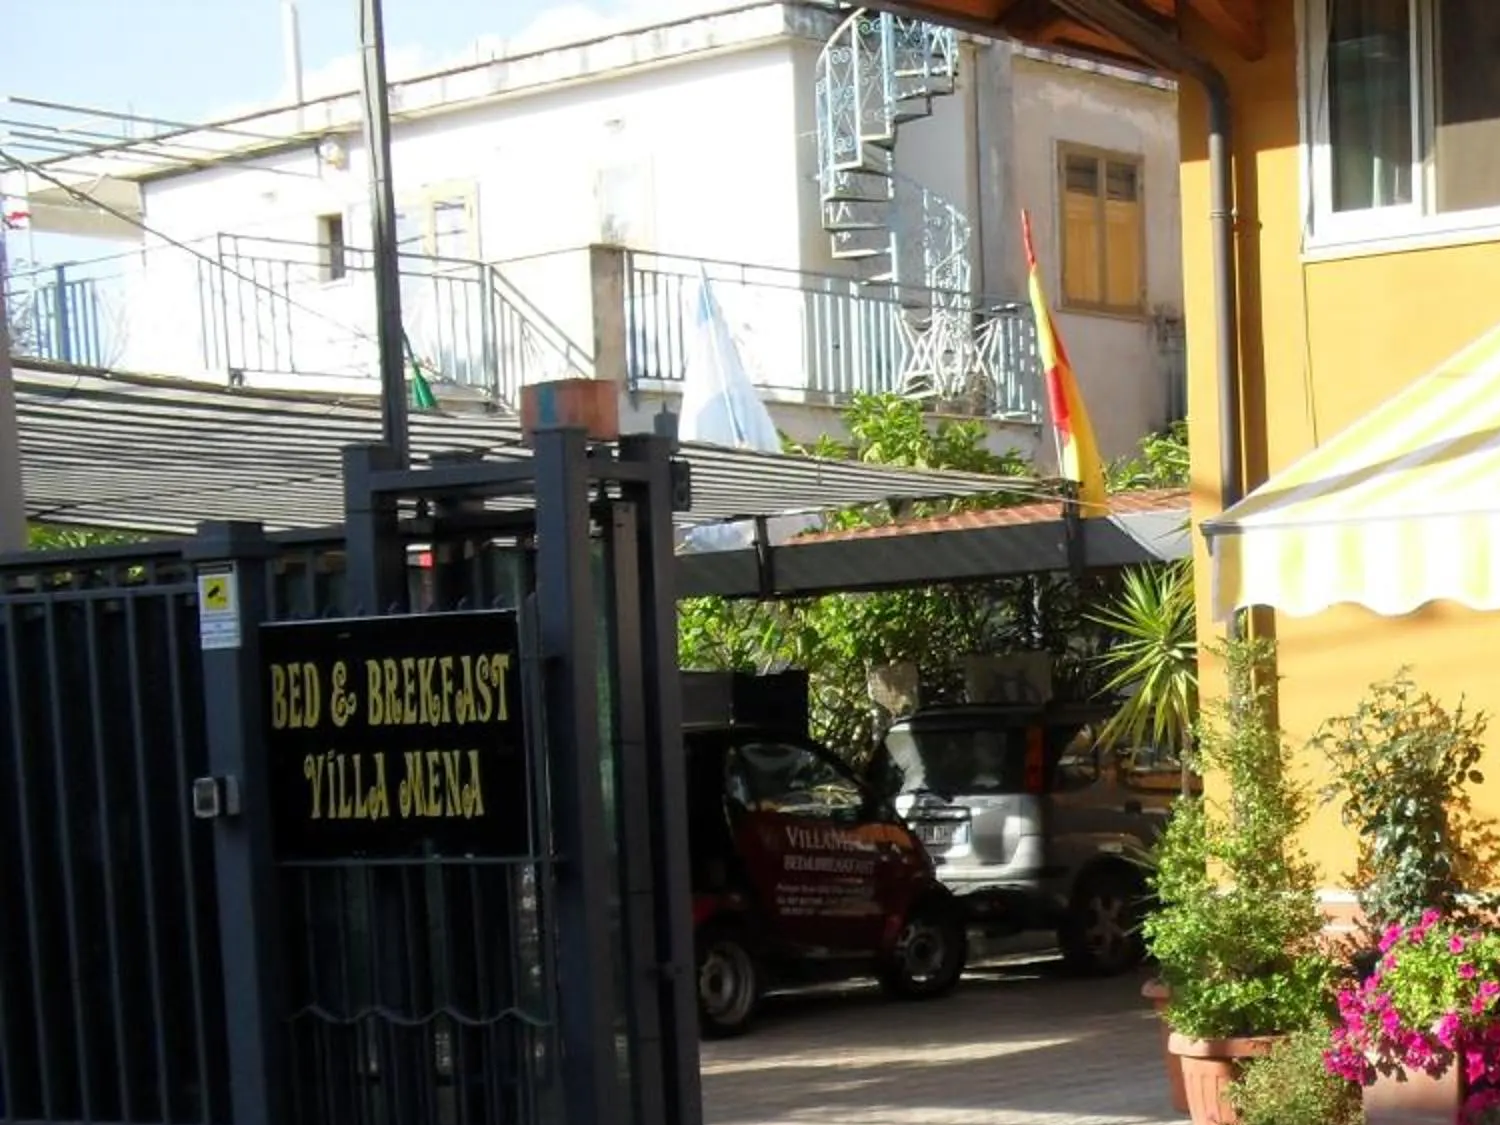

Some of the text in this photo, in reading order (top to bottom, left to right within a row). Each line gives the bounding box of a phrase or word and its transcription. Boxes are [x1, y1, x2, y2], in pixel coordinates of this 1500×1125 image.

[271, 654, 510, 729] BED & BREKFAST
[400, 749, 485, 819] MENA
